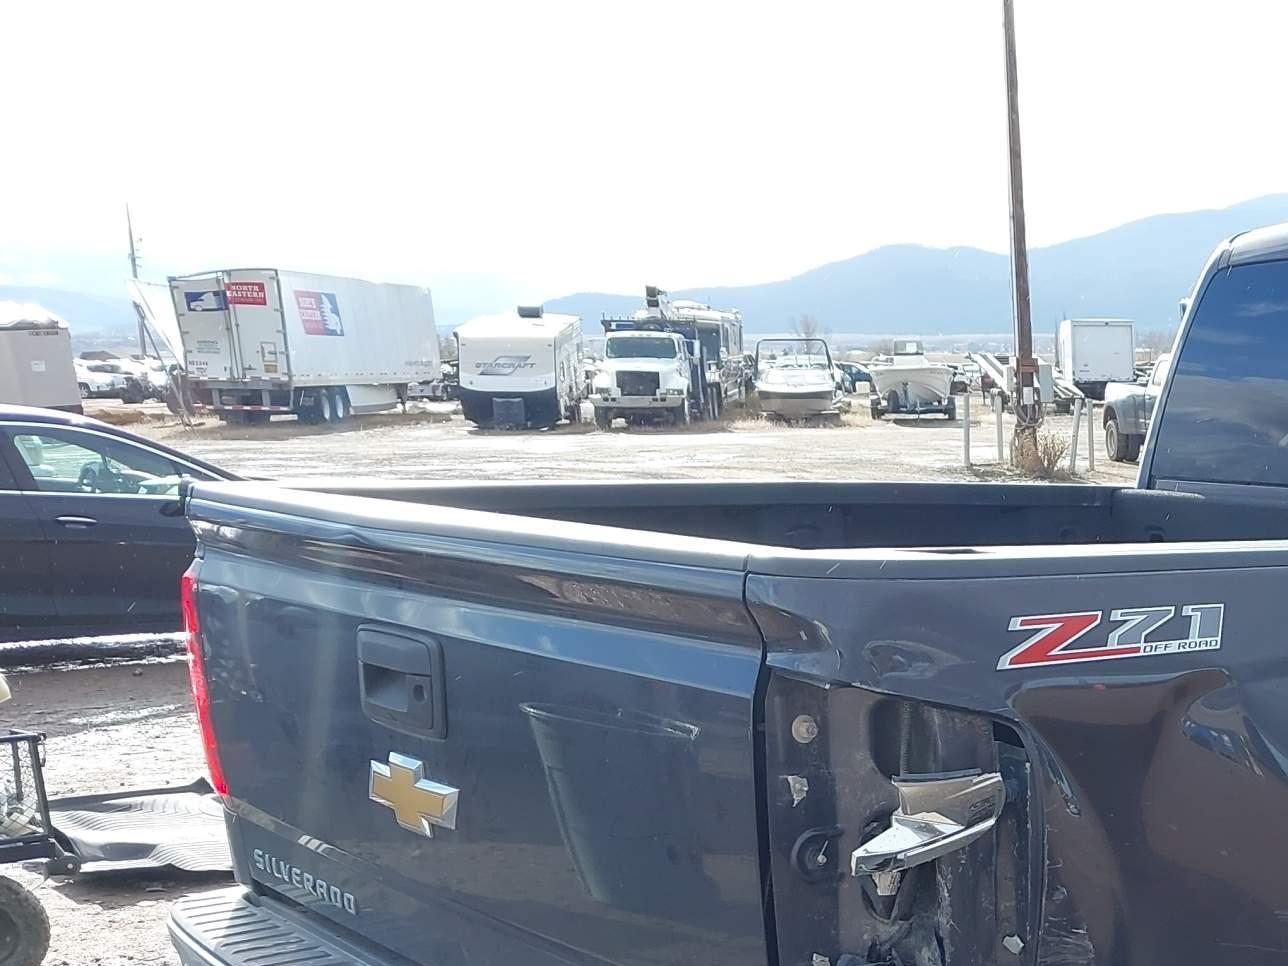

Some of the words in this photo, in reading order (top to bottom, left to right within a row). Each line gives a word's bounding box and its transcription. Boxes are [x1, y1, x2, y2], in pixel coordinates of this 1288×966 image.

[226, 290, 265, 298] EASTERN
[997, 603, 1224, 670] Z71
[1142, 643, 1174, 653] OFF
[1177, 639, 1218, 651] ROAD
[253, 848, 356, 915] SILVERADO
